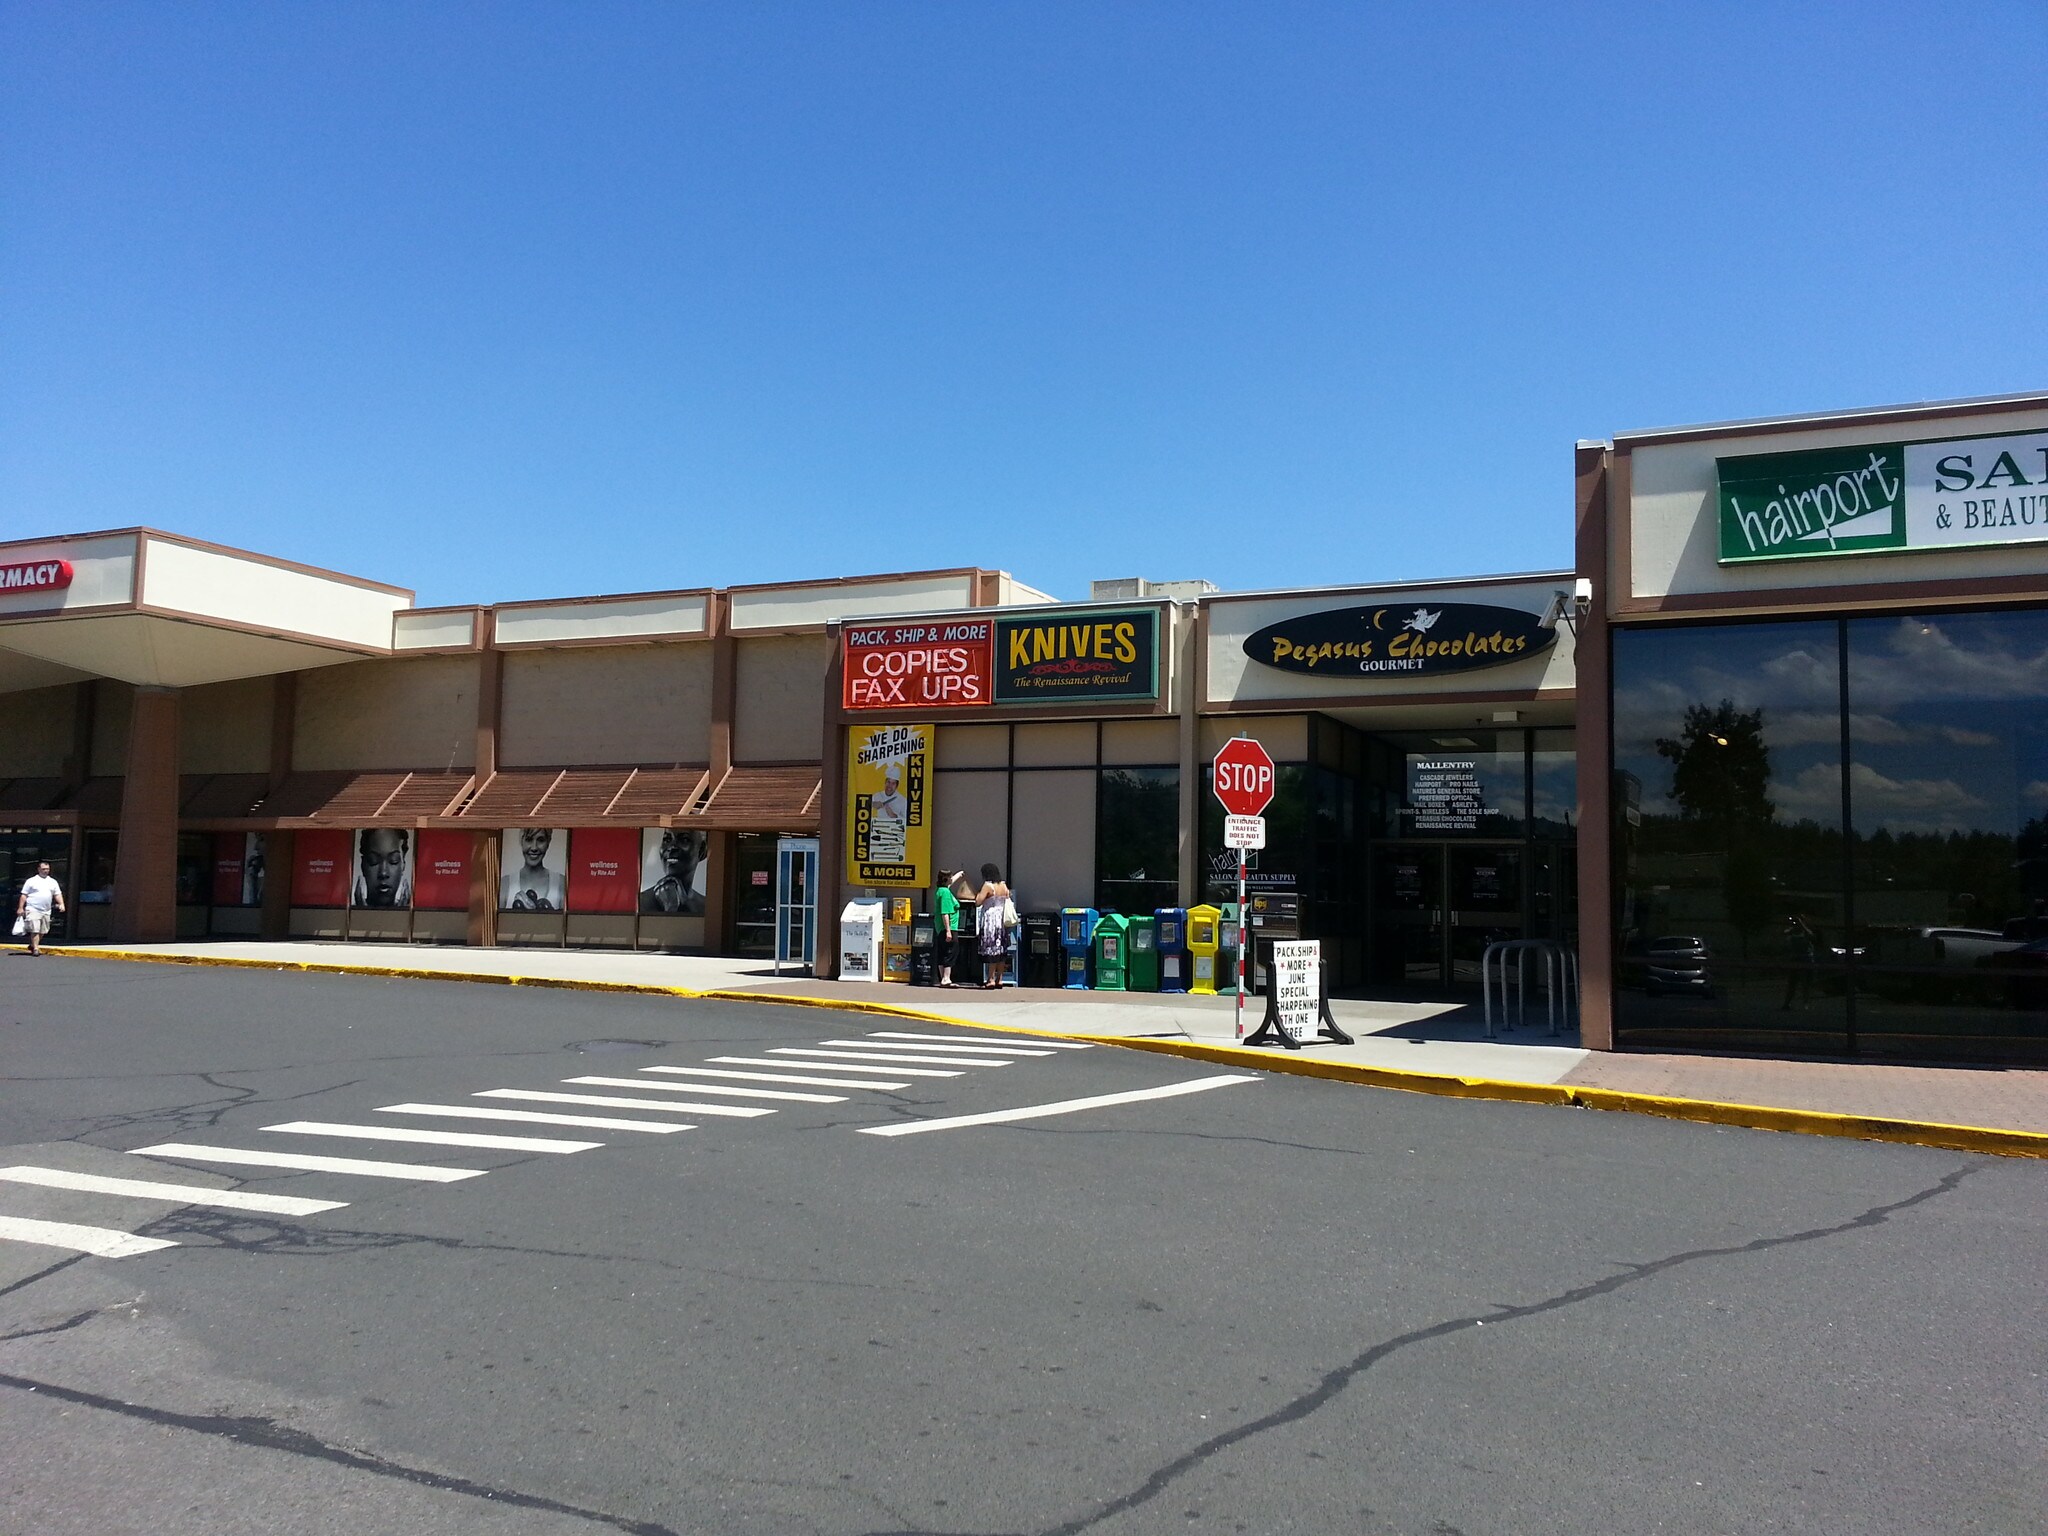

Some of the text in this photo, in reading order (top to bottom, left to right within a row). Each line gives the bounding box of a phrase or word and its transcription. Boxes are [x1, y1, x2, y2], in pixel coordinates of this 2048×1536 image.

[1731, 451, 1899, 551] hairport
[1936, 503, 1952, 529] &
[850, 624, 988, 646] PACK, SHIP & MORE
[1009, 621, 1137, 670] KNIVES
[1271, 629, 1527, 667] Pegasus Chocolates
[862, 647, 969, 677] COPIES
[1359, 658, 1425, 672] GOURMET
[851, 674, 980, 703] FAX UPS
[1013, 672, 1132, 688] The Renaissance Revival
[869, 727, 909, 748] WE DO
[857, 736, 925, 765] SHARPENING
[1218, 761, 1272, 793] STOP
[909, 755, 922, 825] KNIVES
[856, 796, 869, 859] TOOLS
[1228, 818, 1262, 826] ENTRANCE
[434, 860, 461, 868] wellness
[589, 861, 618, 869] wellness
[862, 866, 913, 878] & MORE
[1209, 873, 1233, 881] SALON
[1243, 873, 1269, 881] EAUTY
[1270, 873, 1297, 881] SUPPLY
[1287, 960, 1306, 971] MORE
[1288, 973, 1305, 984] JUNE
[1280, 986, 1309, 998] SPECIAL
[1295, 1013, 1308, 1024] ONE
